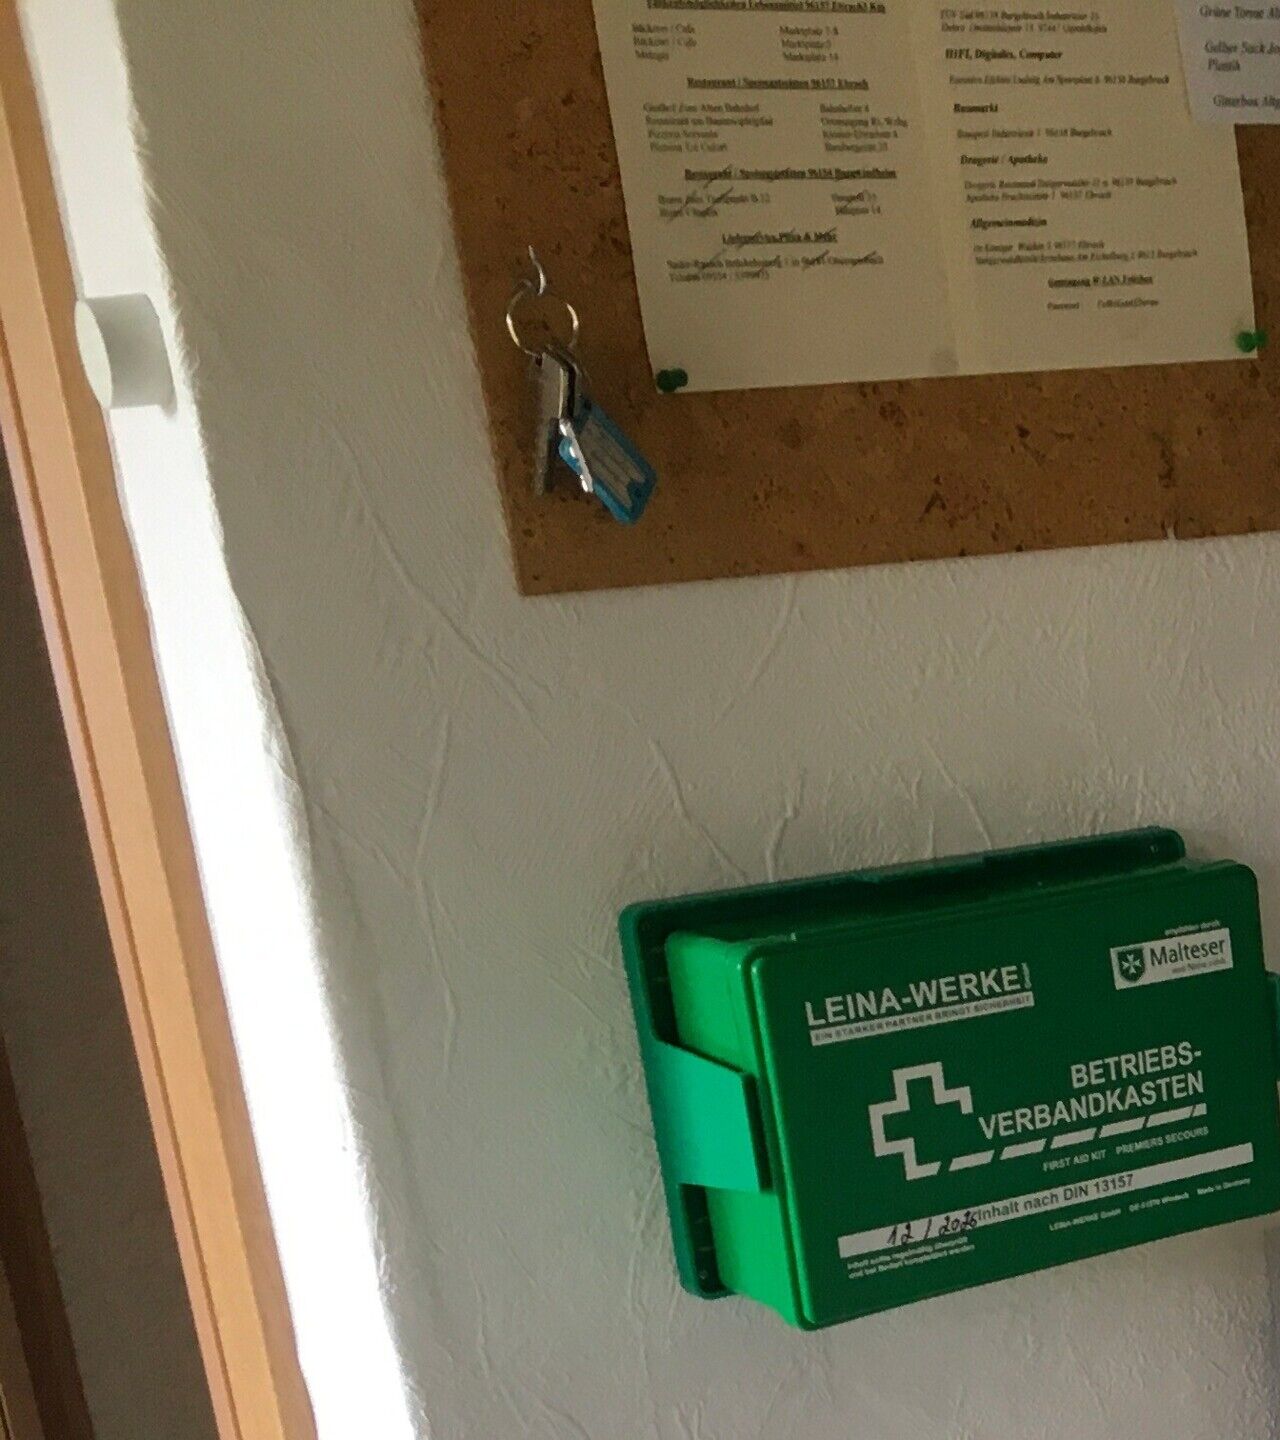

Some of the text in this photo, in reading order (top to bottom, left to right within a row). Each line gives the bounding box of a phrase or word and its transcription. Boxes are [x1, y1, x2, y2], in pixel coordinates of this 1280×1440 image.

[1149, 939, 1227, 967] Malteser
[804, 965, 1022, 1026] LEINA-WERKE
[814, 1031, 833, 1043] EIN
[834, 1022, 884, 1040] STARKER
[885, 1013, 933, 1031] PARTNER
[1070, 1041, 1203, 1089] BETRIEBS-
[978, 1070, 1205, 1141] VERBANDKASTEN
[1043, 1126, 1210, 1173] FIRST AID KIT PREMIERS SECOURS
[978, 1172, 1135, 1222] Inhalt nach DIN 13157
